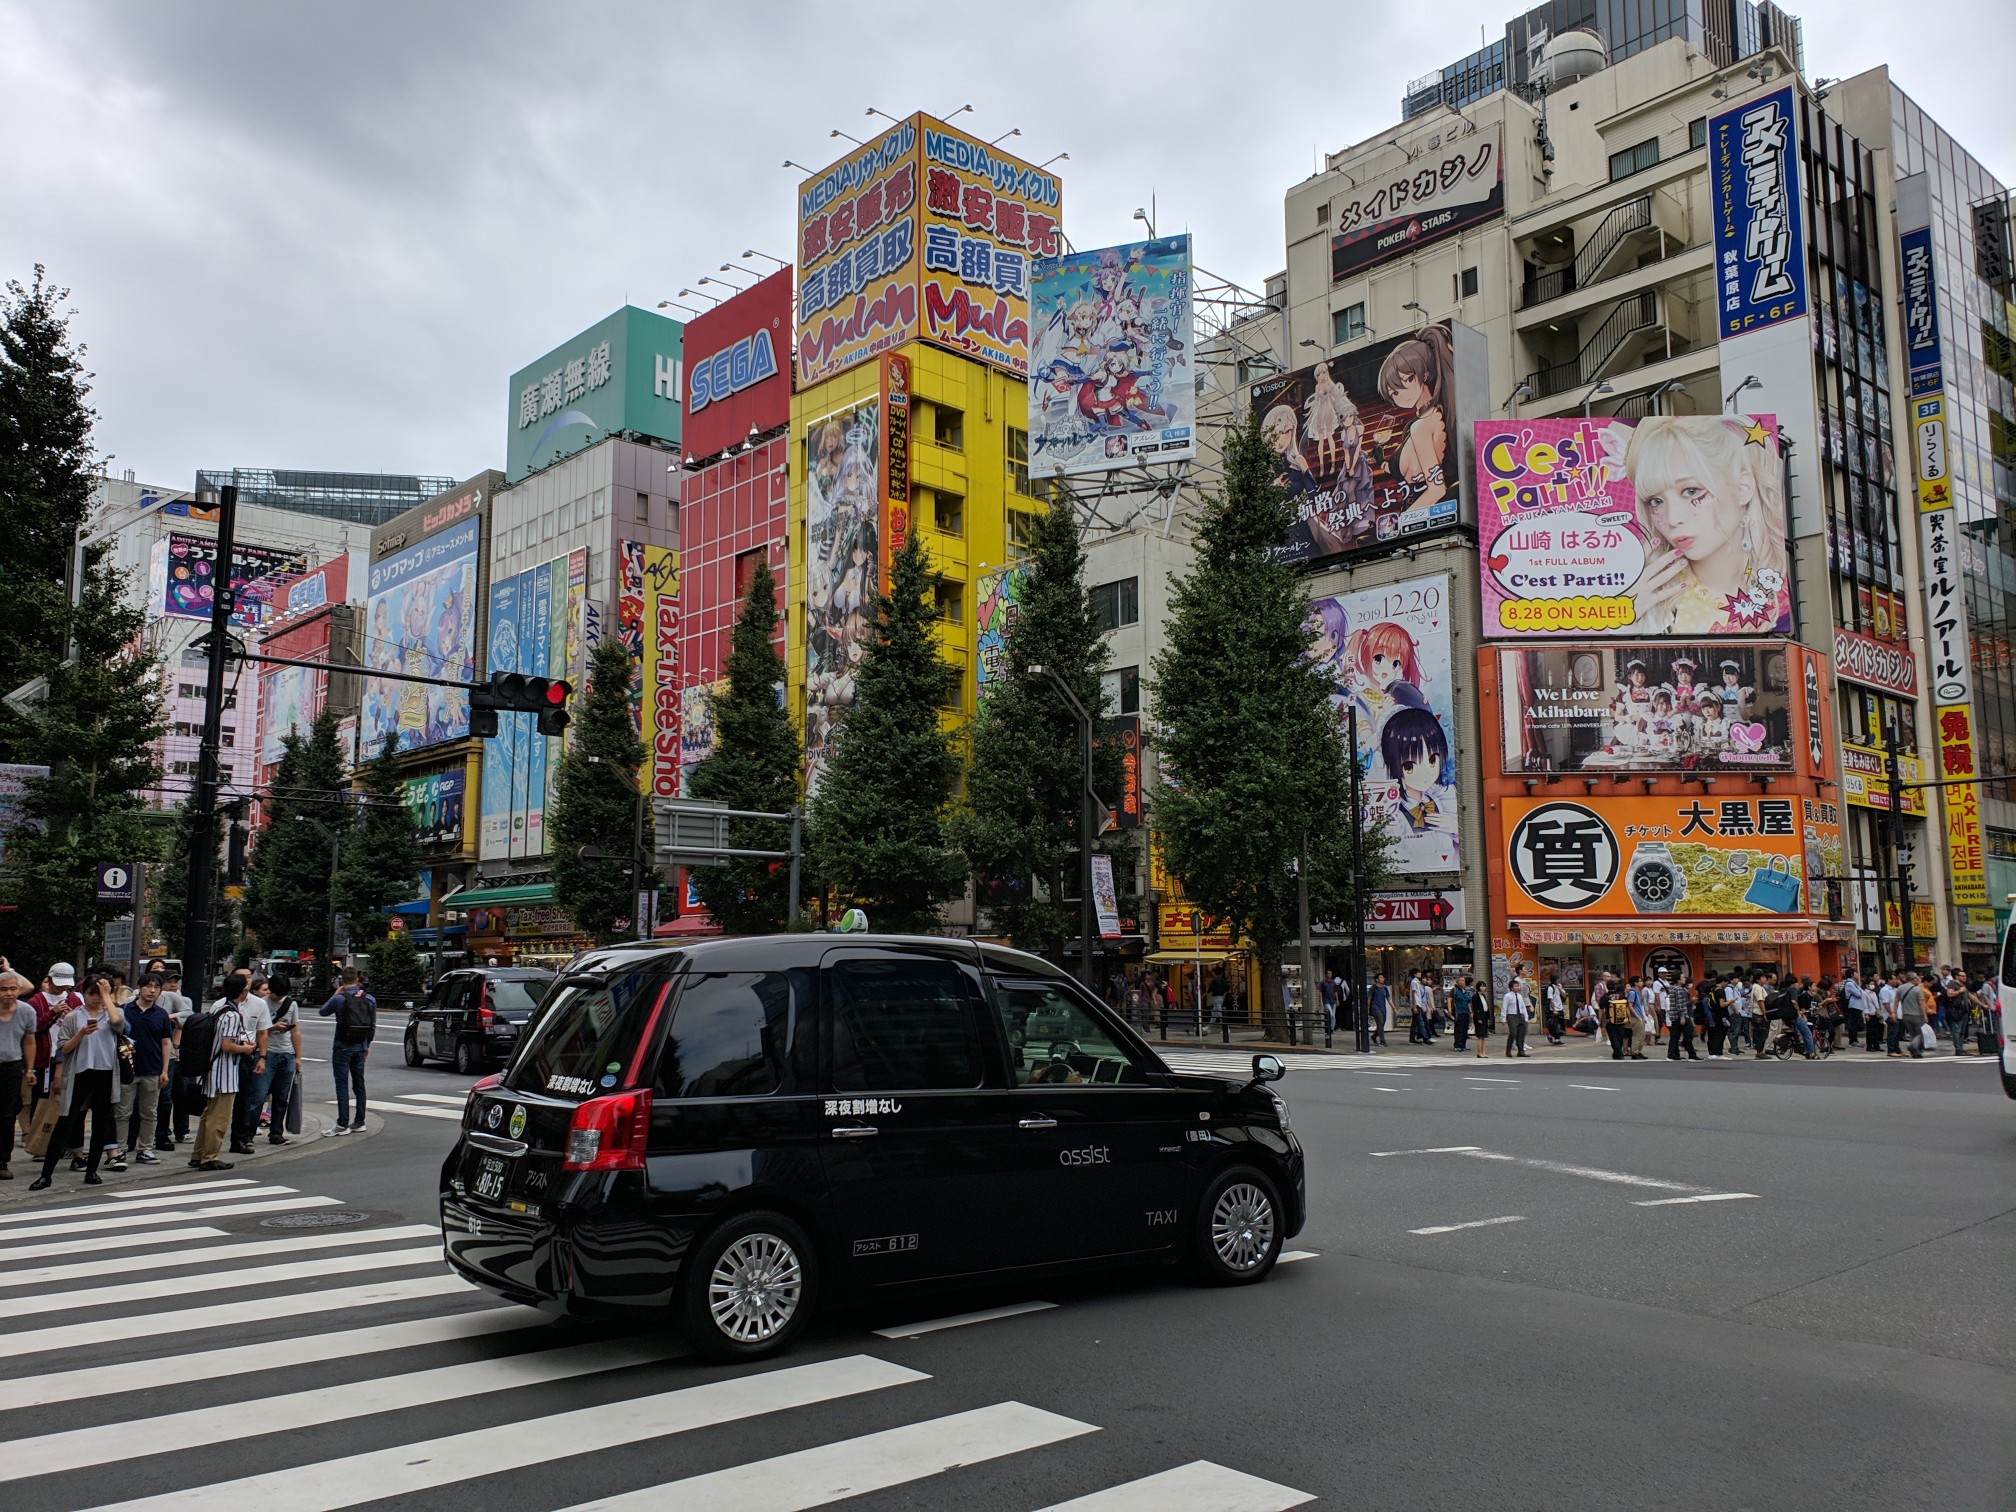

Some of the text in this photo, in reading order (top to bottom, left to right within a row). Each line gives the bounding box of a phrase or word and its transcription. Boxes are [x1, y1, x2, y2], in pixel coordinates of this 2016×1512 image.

[1411, 121, 1475, 158] 小ビル
[802, 122, 916, 221] MEDIAリサイクル
[925, 128, 1058, 207] MEDIAリサイクル
[1339, 143, 1492, 233] メイドカジノ
[1720, 133, 1735, 233] トレーディングカードゲーム
[802, 163, 914, 267] 激安販売
[926, 168, 1057, 257] 激安販売
[1377, 211, 1451, 250] POKER STARS
[800, 217, 913, 324] 高額買取
[925, 225, 1027, 298] 高額買
[1723, 249, 1740, 312] 秋葉原店
[924, 283, 1028, 348] Mula
[800, 283, 916, 381] Mulan
[689, 328, 779, 415] SEGA
[519, 341, 612, 430] 廣瀬無線
[1261, 379, 1288, 395] Yostar
[890, 406, 906, 418] DVD
[1920, 403, 1939, 416] 3F
[890, 427, 906, 439] ゲーム
[892, 438, 904, 448] CD
[1133, 433, 1157, 444] アズレン
[1482, 421, 1603, 480] C'est
[1924, 424, 1941, 478] りらくる
[890, 458, 906, 469] アニメ
[890, 469, 906, 479] コミック
[423, 494, 472, 532] ビックカメラ
[1403, 509, 1426, 522] アズレン
[1501, 497, 1613, 526] HARUKA YAMAZAKI
[1601, 514, 1629, 525] SWEET!
[377, 533, 406, 555] Sofmap
[1561, 530, 1623, 550] はるか
[247, 548, 268, 557] PARK
[1529, 557, 1606, 567] 1st FULL ALBUM
[383, 548, 424, 582] ソフマップ
[1510, 572, 1626, 589] C'est Parti!!
[288, 571, 327, 620] SEGA
[1421, 610, 1439, 621] SALE
[1508, 605, 1628, 621] 8.28 ON SALE!!
[1835, 634, 1915, 690] メイドカジノ
[1533, 687, 1599, 700] We Love
[1525, 705, 1612, 719] Akihabara
[1940, 711, 1973, 776] 免税
[1846, 776, 1863, 791] りらくる
[1678, 800, 1795, 836] 大黒屋
[1624, 825, 1673, 838] チケット
[1966, 821, 1984, 871] FREE
[1524, 819, 1604, 896] 質
[1392, 901, 1419, 919] ZIN
[547, 1075, 596, 1095] 深夜割増なし
[825, 1098, 902, 1116] 深夜割増なし
[1060, 1145, 1112, 1166] assist
[478, 1171, 504, 1198] 80-15
[526, 1169, 548, 1190] アシスト
[468, 1216, 482, 1237] 612
[1146, 1209, 1179, 1226] TAXI
[856, 1236, 917, 1253] アシスト 612
